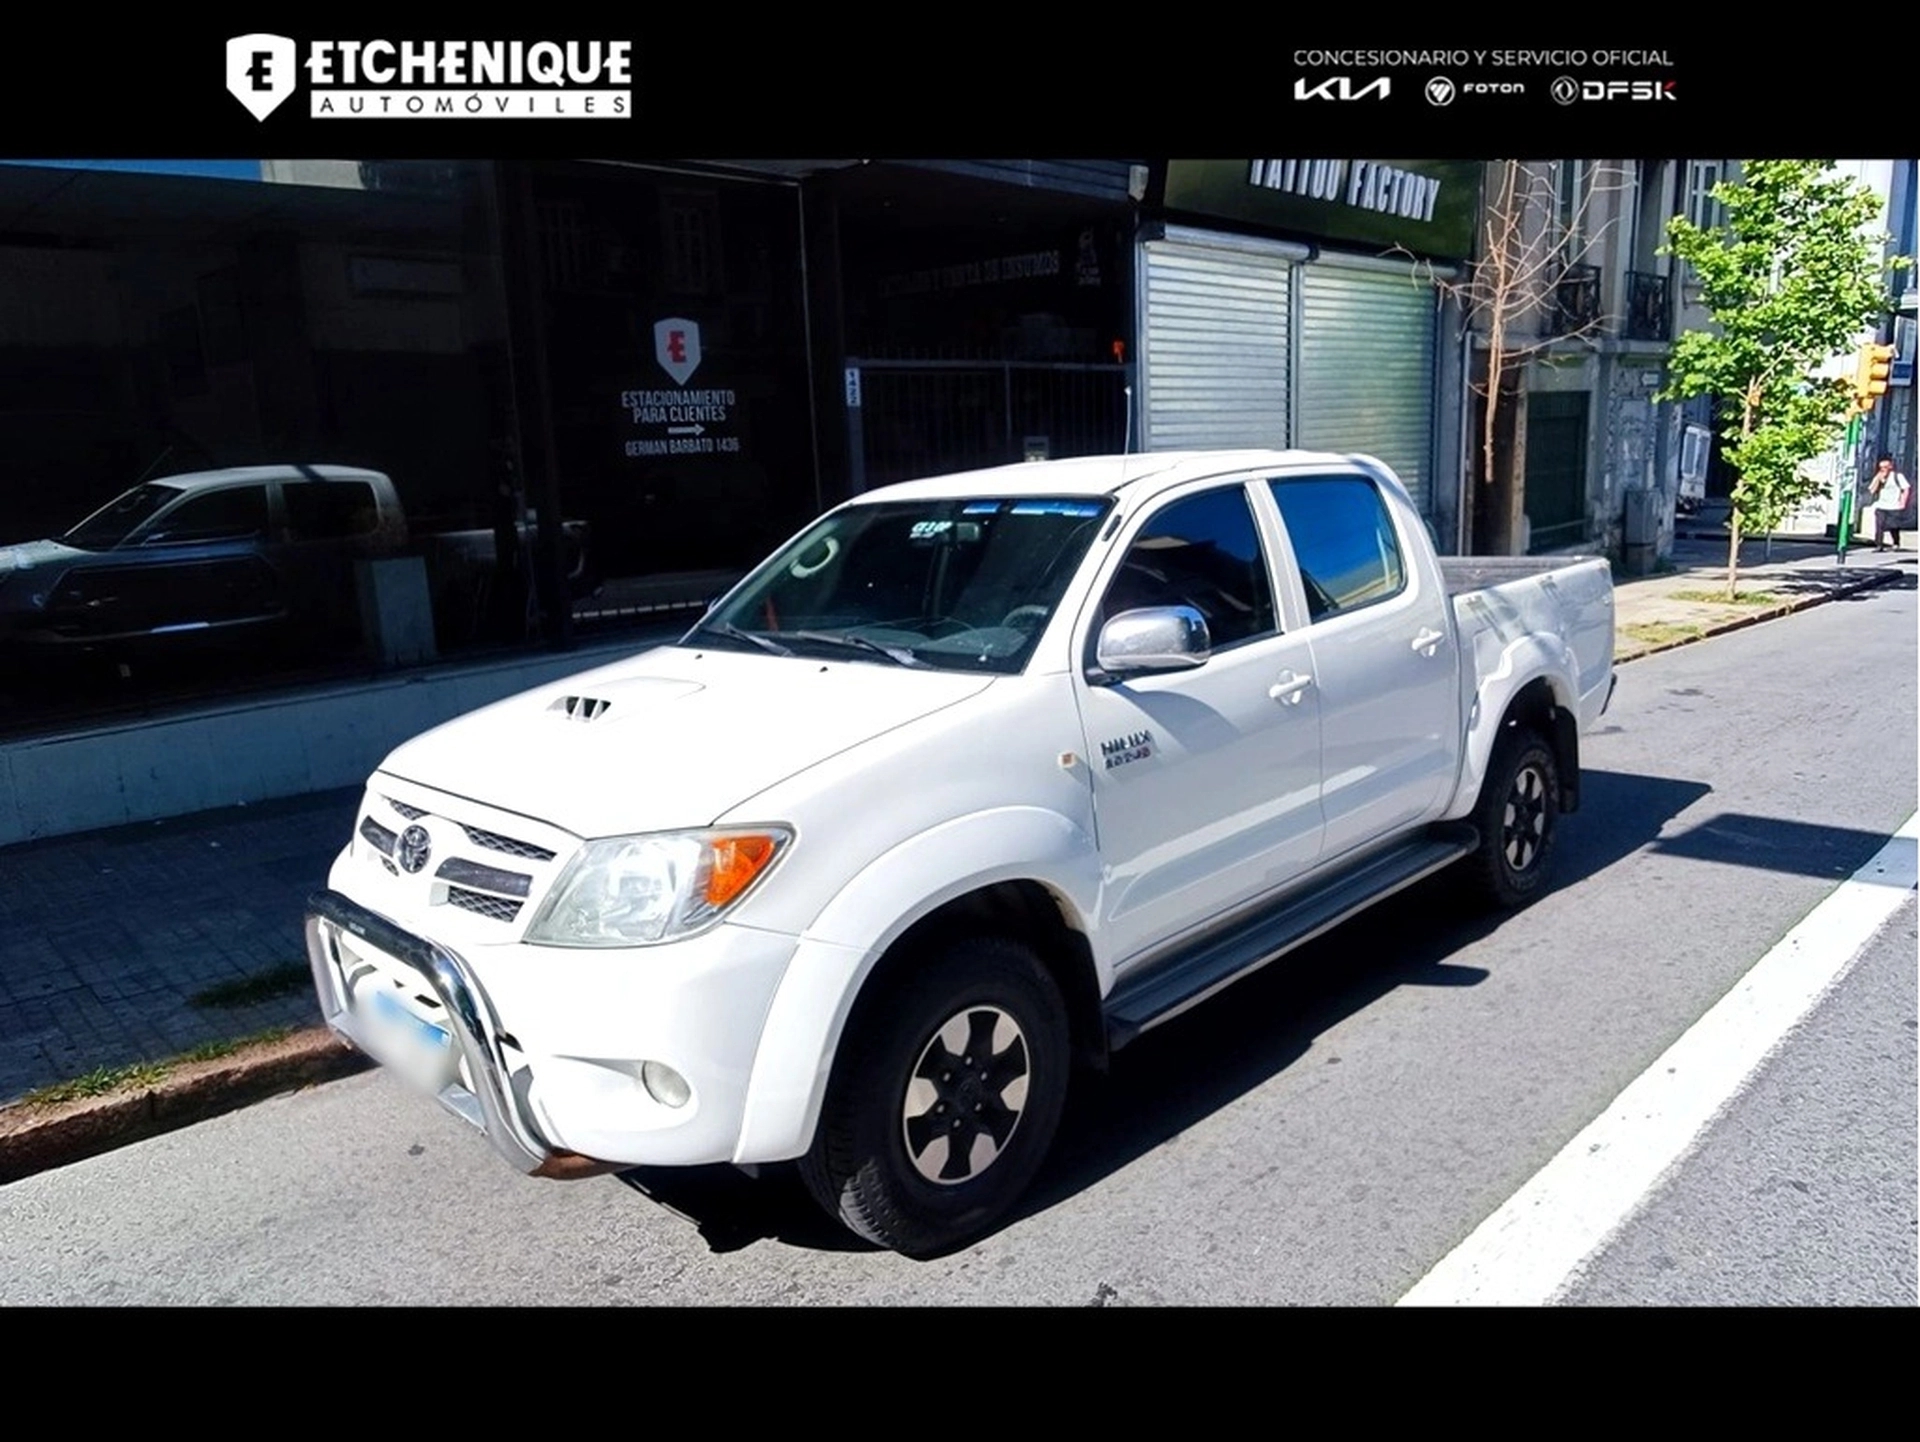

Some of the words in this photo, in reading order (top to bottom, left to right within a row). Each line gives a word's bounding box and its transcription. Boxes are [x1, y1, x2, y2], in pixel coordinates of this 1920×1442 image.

[1346, 160, 1440, 222] FACTORY
[621, 390, 735, 408] ESTACIONAMIENTO
[633, 407, 668, 423] PARA
[669, 405, 726, 422] CLIENTES
[1101, 730, 1151, 756] HILUX
